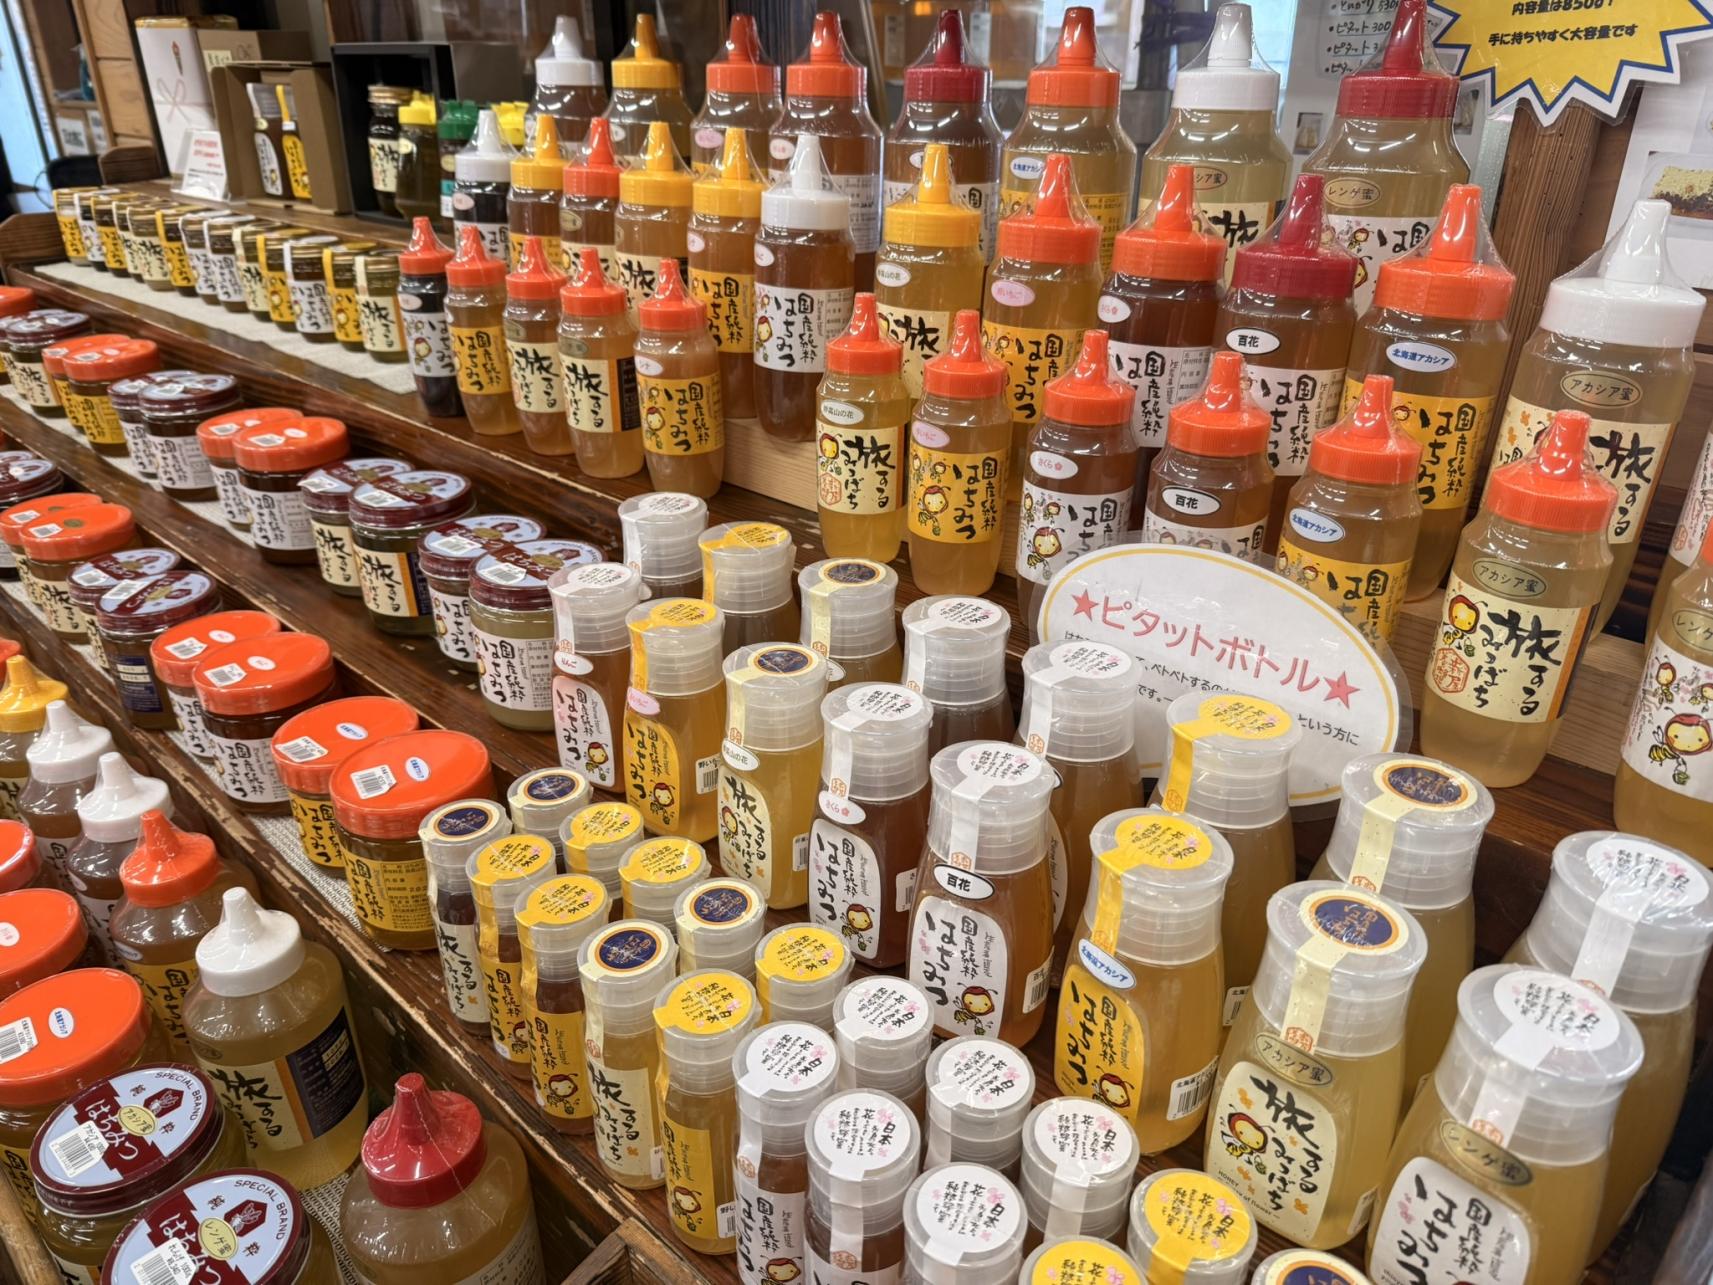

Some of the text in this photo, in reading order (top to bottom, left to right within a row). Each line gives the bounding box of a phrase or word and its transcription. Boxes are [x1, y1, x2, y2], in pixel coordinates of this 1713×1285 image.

[1488, 24, 1638, 46] 手に持ちやすく大容量です
[774, 296, 800, 367] はちみつ
[1238, 335, 1259, 348] 百花
[1392, 348, 1451, 365] 北海道アカシア
[1570, 378, 1635, 402] アカシア蜜
[664, 386, 694, 452] はちみつ
[1289, 374, 1318, 465] 国産純粋
[842, 435, 896, 508] 旅する
[1443, 403, 1477, 496] 国産純粋
[952, 463, 981, 540] はちみつ
[1175, 494, 1199, 510] 百花
[1588, 430, 1656, 538] 旅する
[1479, 566, 1539, 593] アカシア蜜
[1101, 595, 1322, 693] ピタットボトル
[1473, 623, 1508, 709] みつばち
[1487, 609, 1563, 716] 旅する
[1298, 714, 1361, 746] という方に
[815, 832, 841, 921] はちみつ
[946, 872, 971, 893] 百花
[922, 910, 958, 1007] はちみつ
[891, 1010, 916, 1029] 日本
[1066, 981, 1098, 1086] はちみつ
[797, 1057, 824, 1078] 日本
[1260, 1040, 1327, 1083] アカシア蜜
[155, 1071, 203, 1121] SPECIAL BRAND
[988, 1078, 1015, 1098] 日本
[878, 1121, 897, 1147] 日本
[1099, 1128, 1118, 1153] 日本
[1248, 1075, 1324, 1195] 旅する
[234, 1179, 288, 1241] SPECIAL BRAND
[982, 1202, 1006, 1231] 日本
[1213, 1214, 1237, 1242] 日本
